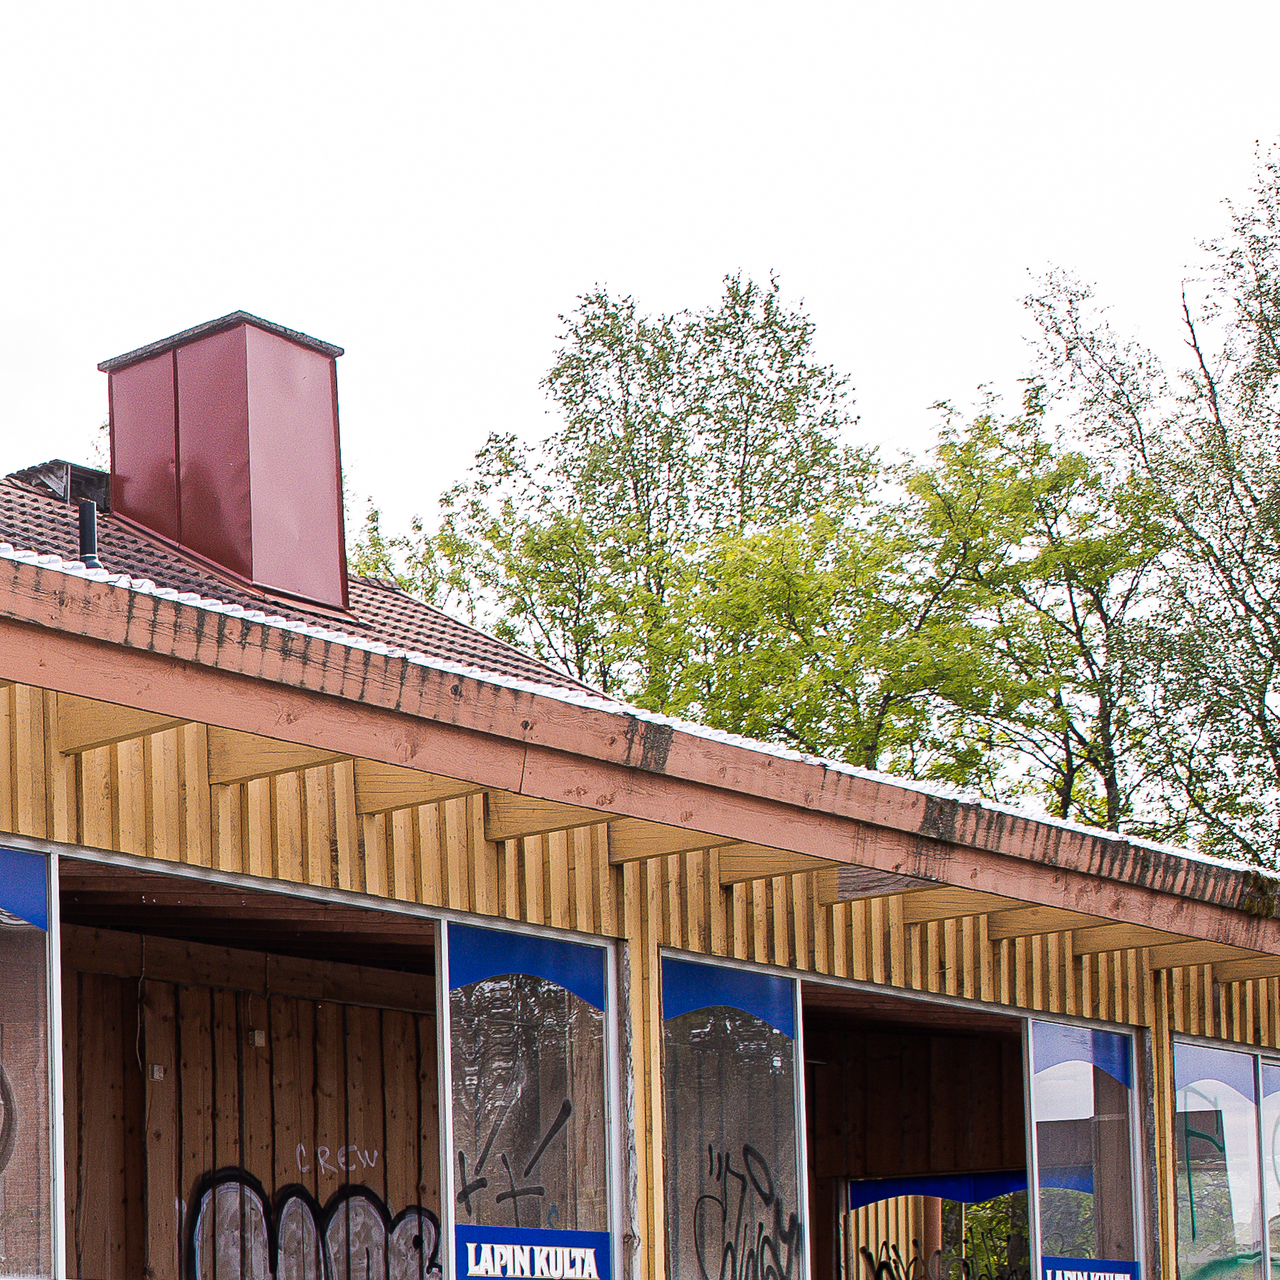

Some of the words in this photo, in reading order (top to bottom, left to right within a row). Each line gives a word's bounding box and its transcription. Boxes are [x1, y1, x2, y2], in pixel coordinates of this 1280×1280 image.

[296, 1143, 378, 1174] CREW
[466, 1242, 532, 1278] LAPIN
[532, 1246, 600, 1280] KULTA
